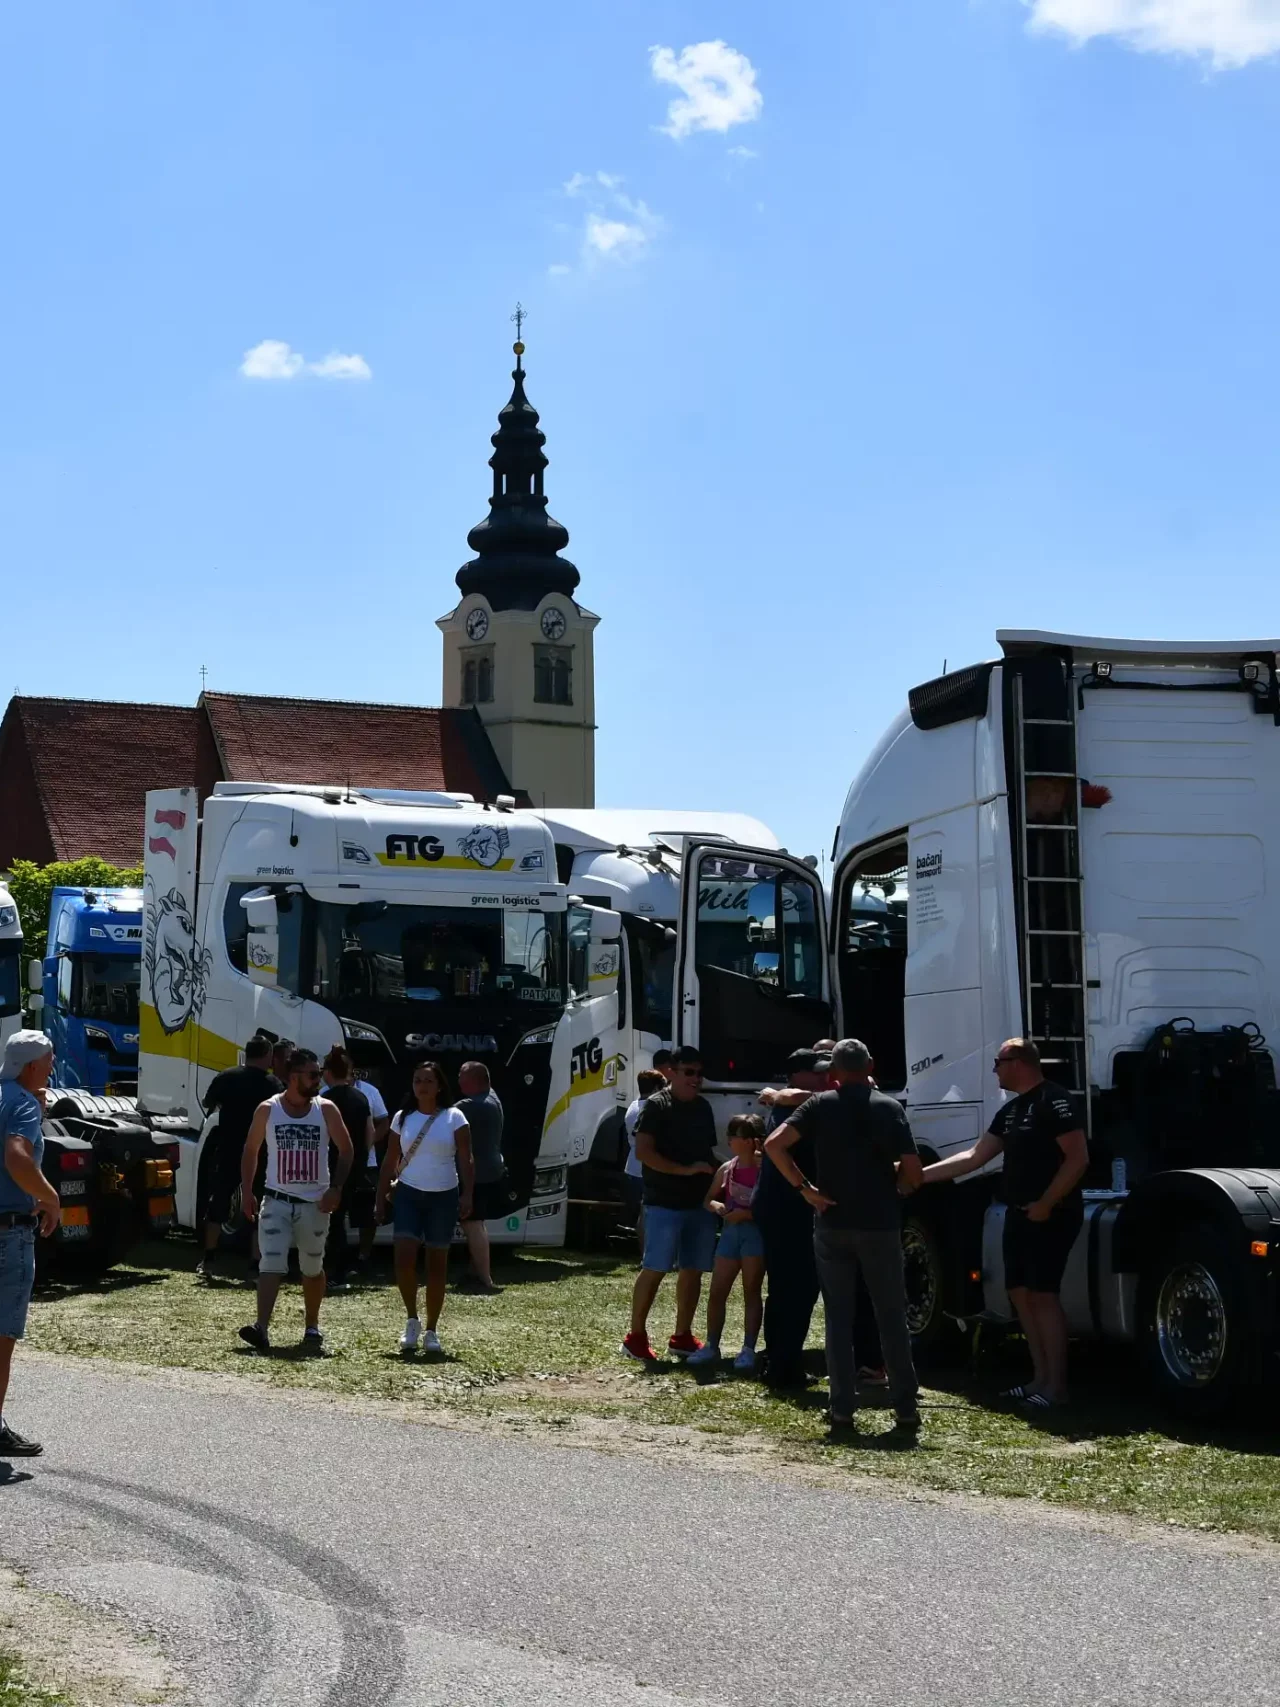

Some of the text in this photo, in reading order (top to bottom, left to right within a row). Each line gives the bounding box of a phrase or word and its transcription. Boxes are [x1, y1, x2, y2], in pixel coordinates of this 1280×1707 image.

[385, 834, 445, 862] FTG
[916, 849, 943, 869] bačani
[255, 864, 294, 876] green logistics
[915, 865, 942, 879] transporti
[471, 895, 540, 906] green logistics
[404, 1032, 499, 1053] SCANIA
[570, 1036, 603, 1085] FTG
[910, 1056, 931, 1075] 500
[276, 1139, 321, 1150] SURF PRIDE
